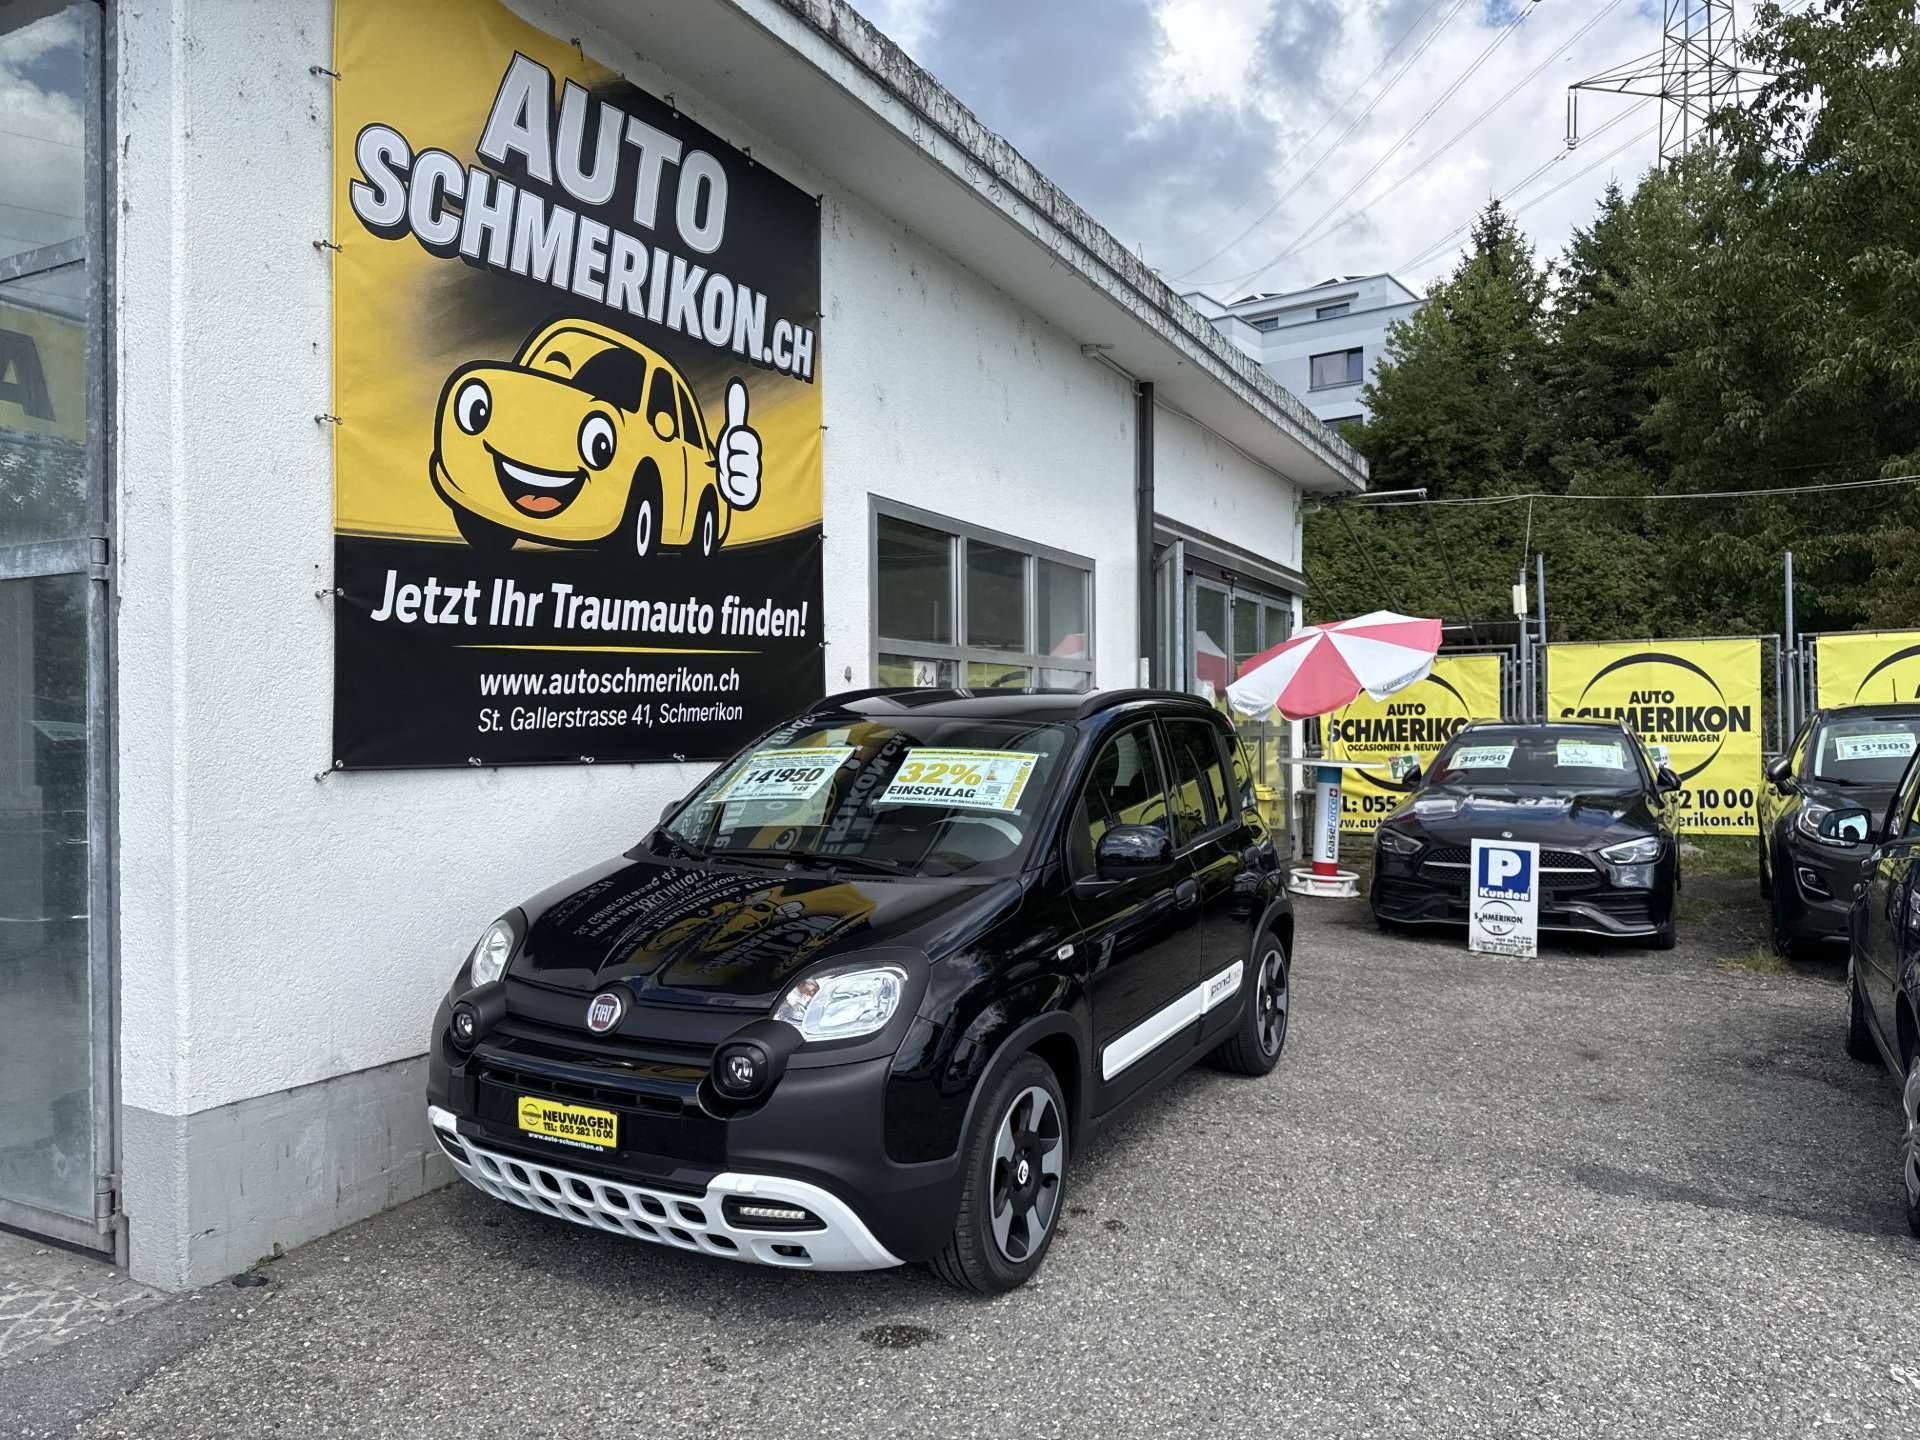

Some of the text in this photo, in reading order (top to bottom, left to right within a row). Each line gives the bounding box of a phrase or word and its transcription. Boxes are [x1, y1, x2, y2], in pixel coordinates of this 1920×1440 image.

[478, 51, 729, 255] AUTO
[350, 123, 815, 380] SCHMERIKON.CH
[370, 569, 808, 637] Jetzt Ihr Traumauto finden!
[480, 667, 740, 696] www.autoschmerikon.ch
[1629, 690, 1675, 705] AUTO
[478, 702, 743, 732] St. Gallerstrasse 41, Schmerikon
[1386, 703, 1426, 716] AUTO
[1328, 717, 1469, 742] SCHMERIK
[1661, 734, 1720, 743] NEUWAGEN
[1347, 743, 1401, 752] OCCASIONEN
[743, 767, 826, 785] 14'950
[897, 762, 982, 786] 32%
[887, 785, 977, 799] EINSCHLAG
[1697, 789, 1719, 809] 10
[1723, 788, 1754, 808] 00
[1362, 795, 1397, 813] 055
[1679, 811, 1755, 827] erikon.ch
[1488, 849, 1522, 887] P
[1479, 886, 1530, 902] Kunden
[593, 1003, 615, 1023] FIAT
[543, 1110, 614, 1130] NEUWAGEN
[543, 1122, 614, 1139] TEL: 055 282 10 00
